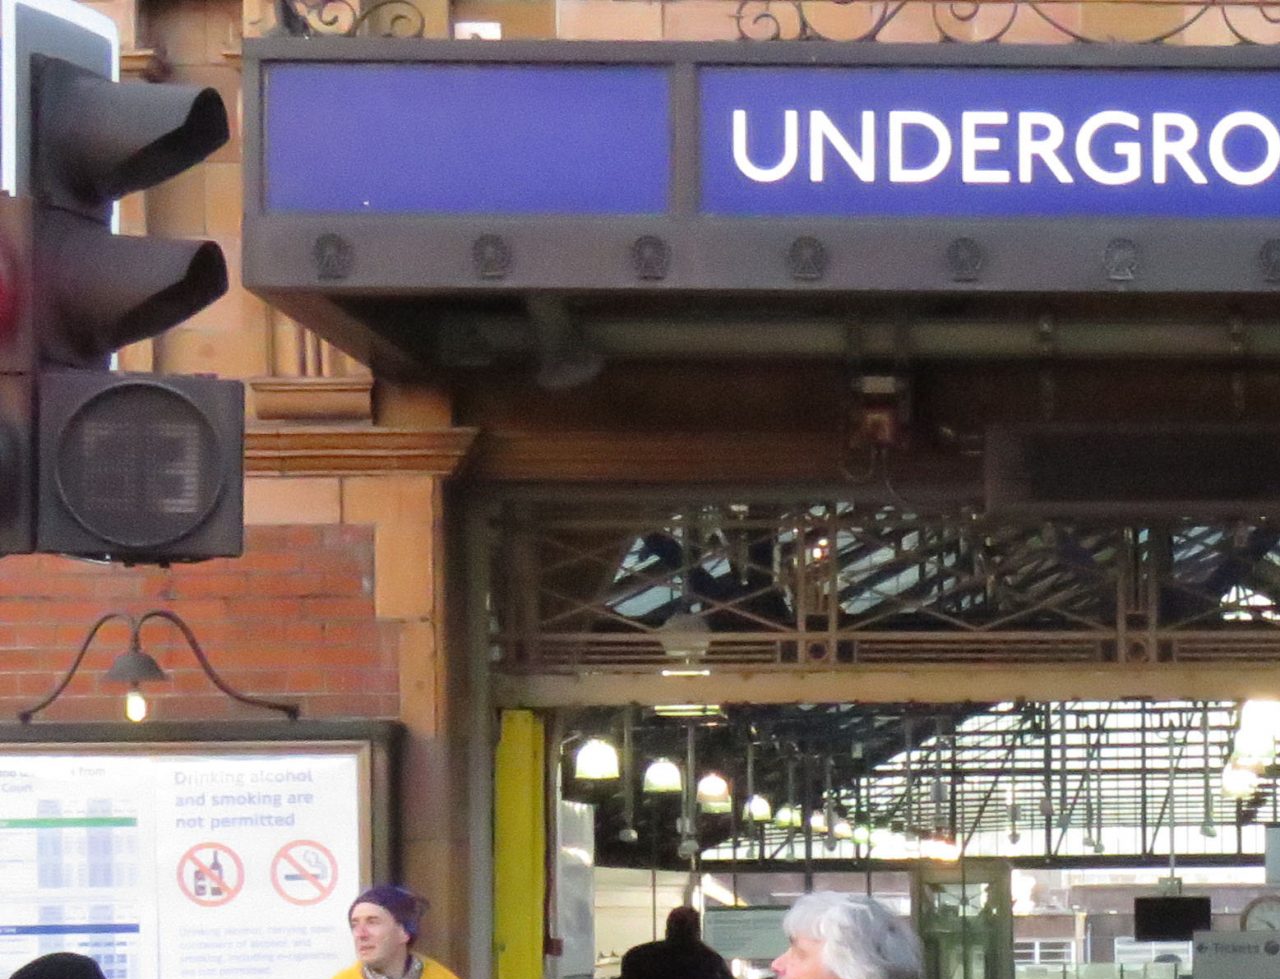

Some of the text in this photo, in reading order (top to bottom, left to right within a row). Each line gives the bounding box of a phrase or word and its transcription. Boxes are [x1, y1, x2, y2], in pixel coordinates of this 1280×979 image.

[174, 769, 314, 787] Drinking alcohol
[175, 791, 314, 808] and smoking are
[175, 812, 296, 830] not permitted
[1212, 942, 1260, 955] Tickets
